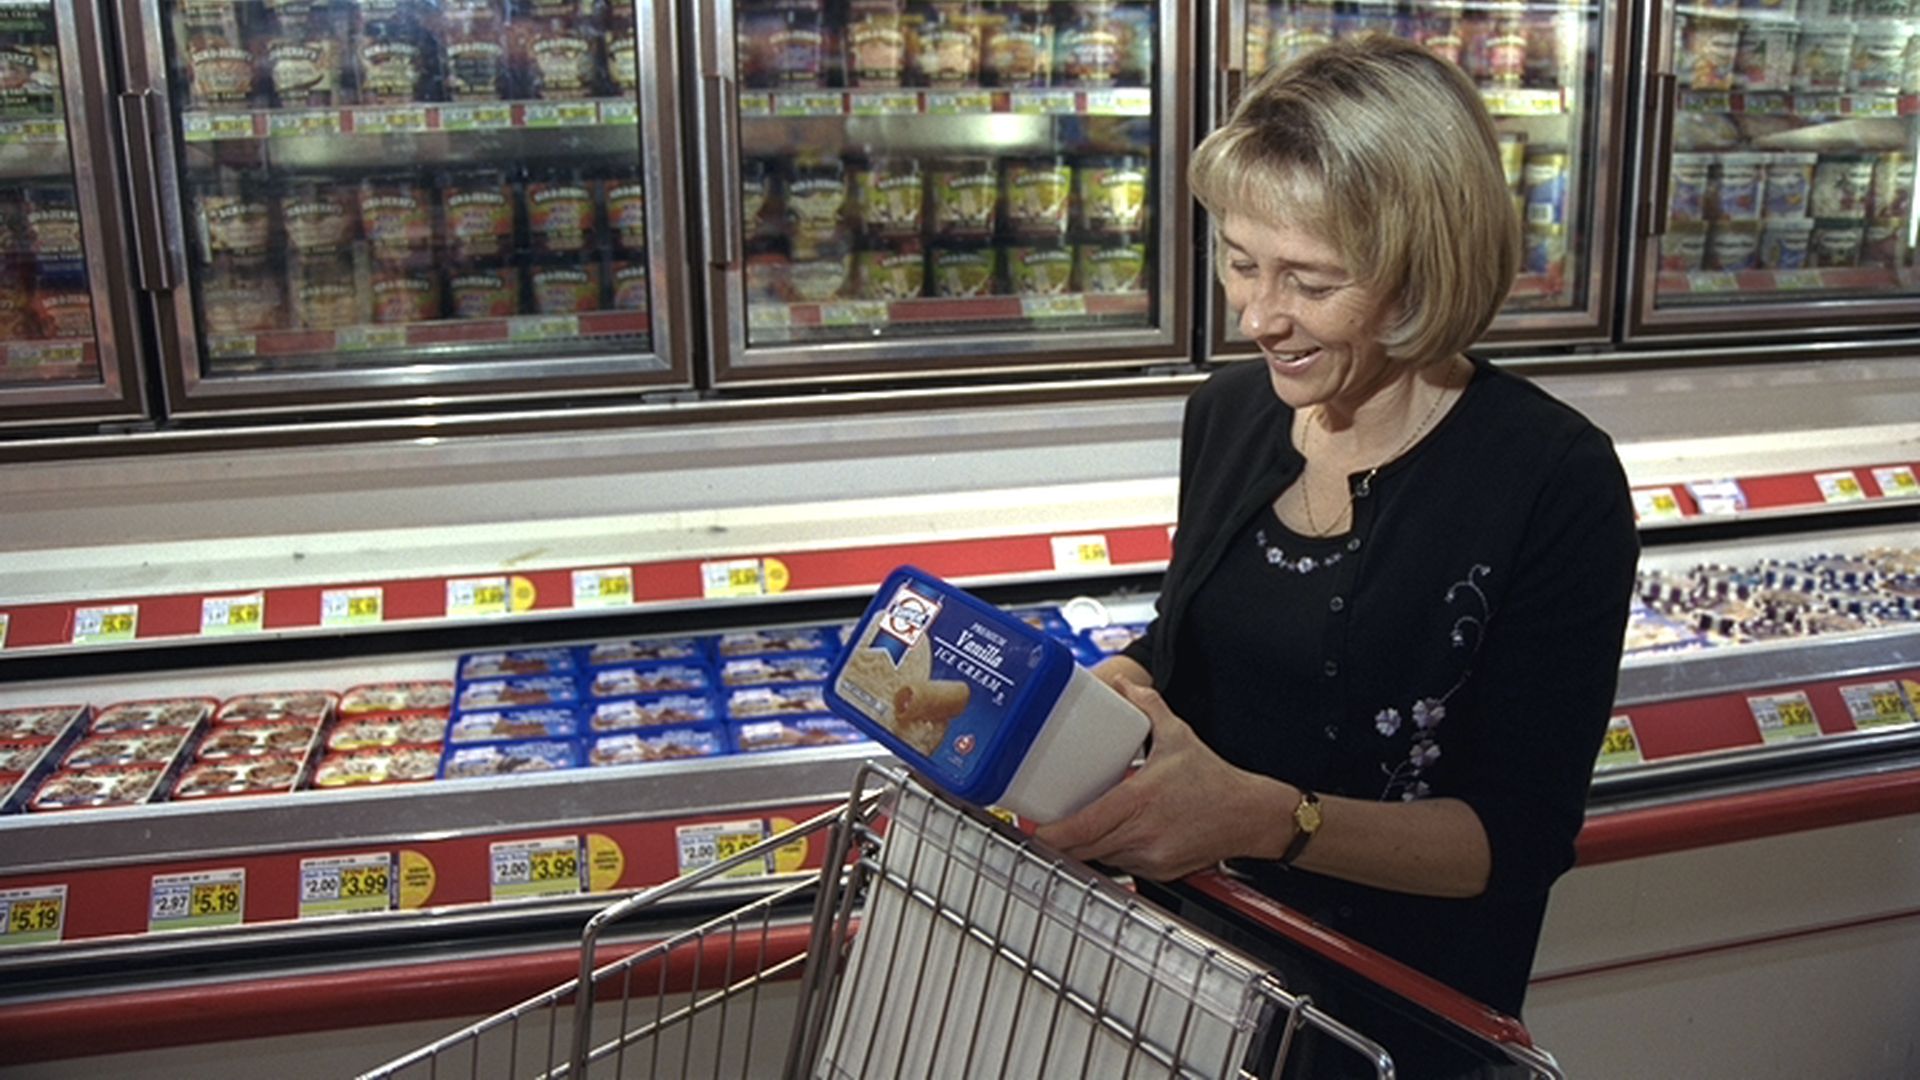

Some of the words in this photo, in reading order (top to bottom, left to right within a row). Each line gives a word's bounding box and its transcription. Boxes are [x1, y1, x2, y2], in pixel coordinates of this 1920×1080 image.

[956, 629, 1004, 668] Vanilla
[934, 646, 958, 666] ICE
[956, 660, 1002, 693] CREAM
[497, 862, 528, 877] $2.00
[532, 856, 578, 880] $3.99
[306, 877, 338, 894] $2.00
[342, 873, 389, 897] $3.99
[194, 891, 238, 914] $5.19
[11, 907, 57, 930] $5.19
